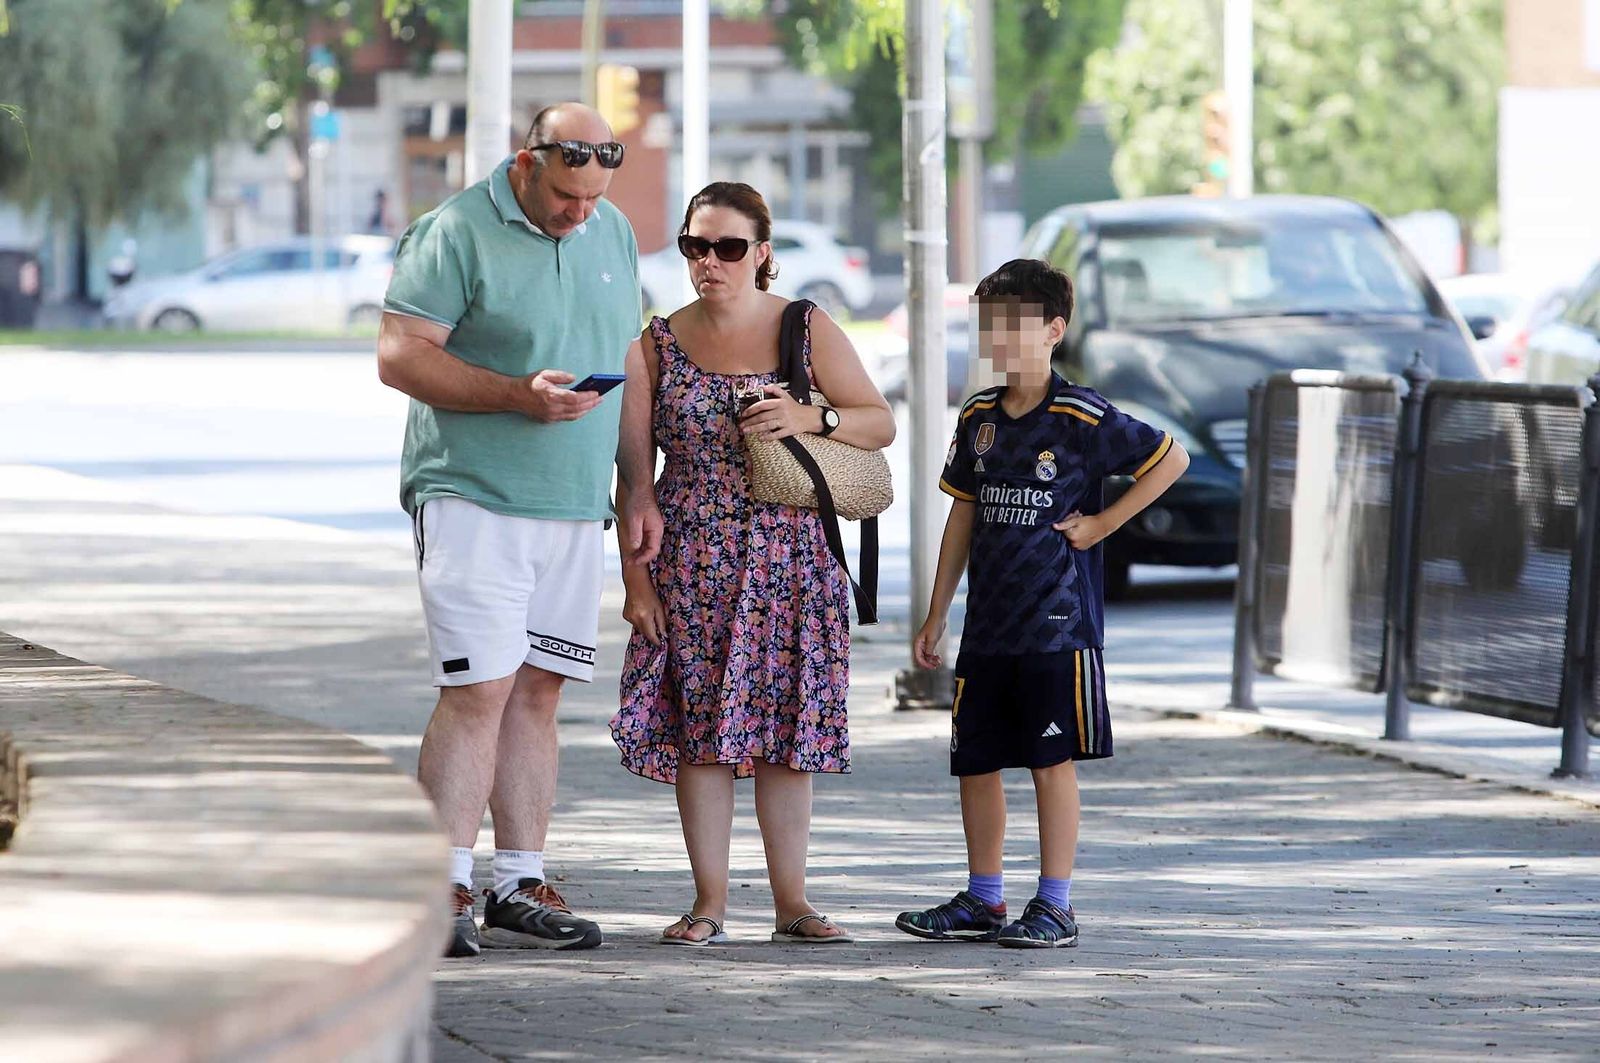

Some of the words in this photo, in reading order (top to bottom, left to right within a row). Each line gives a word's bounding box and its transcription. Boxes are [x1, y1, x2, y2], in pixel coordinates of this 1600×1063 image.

[980, 483, 1053, 507] Emirates
[983, 506, 997, 523] FLY
[997, 507, 1037, 525] BETTER
[540, 639, 592, 659] SOUTH
